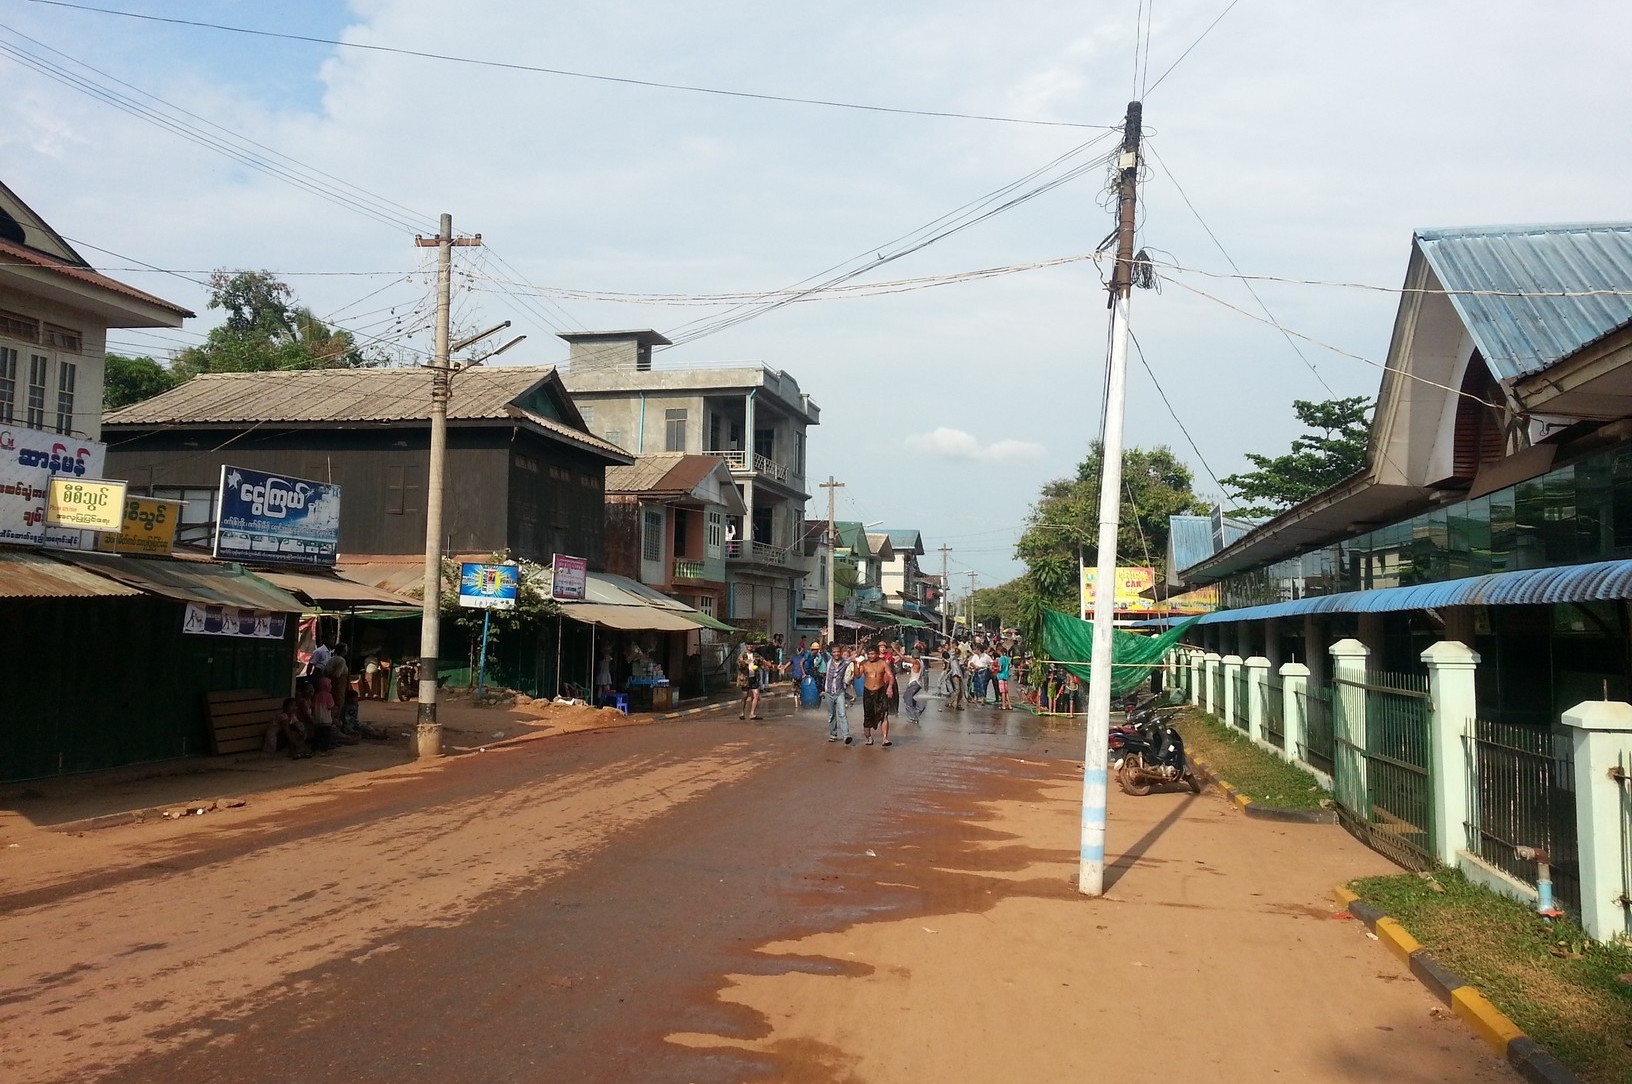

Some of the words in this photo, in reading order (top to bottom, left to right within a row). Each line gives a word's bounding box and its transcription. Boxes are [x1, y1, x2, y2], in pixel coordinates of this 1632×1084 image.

[240, 478, 310, 518] ငွေကြယ်
[1125, 580, 1142, 588] CAR
